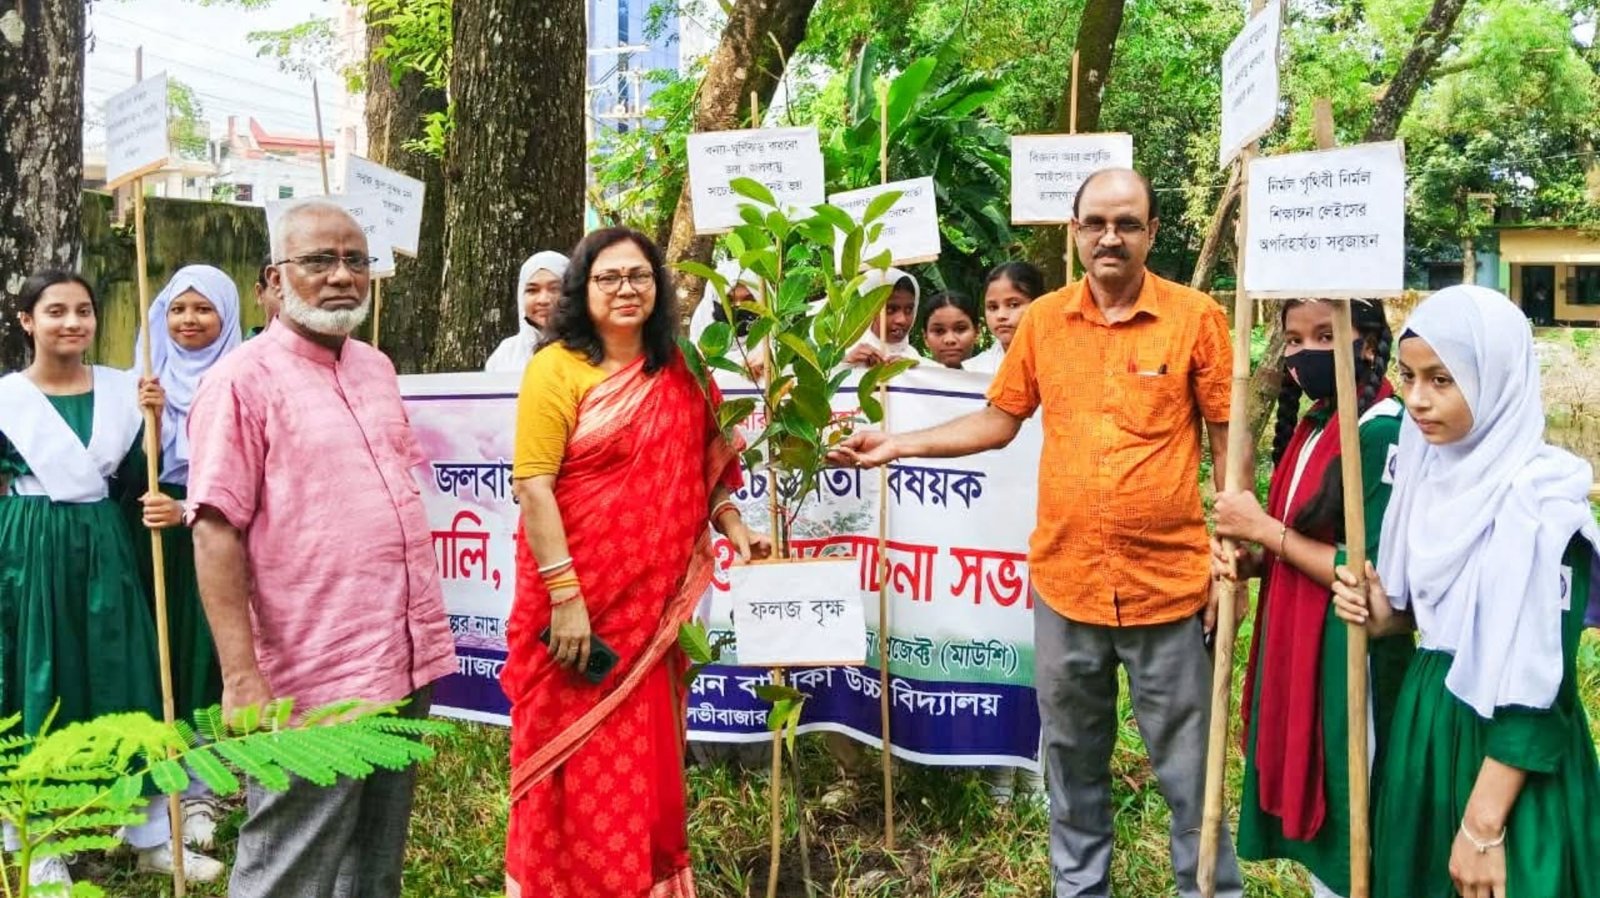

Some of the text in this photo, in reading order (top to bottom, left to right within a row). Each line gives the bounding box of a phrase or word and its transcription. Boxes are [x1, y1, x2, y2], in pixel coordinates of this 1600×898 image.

[1268, 167, 1372, 196] নির্মল পৃথিবী নির্মল
[1319, 202, 1367, 220] লেইসের
[1260, 232, 1380, 252] অপরিহার্যতা সবুজায়ন
[750, 599, 846, 627] ফলজ বৃক্ষ
[474, 616, 500, 636] নাম
[940, 641, 1019, 676] (মাউশি)
[890, 678, 1003, 716] বিদ্যালয়
[686, 702, 770, 726] লভীবাজার
